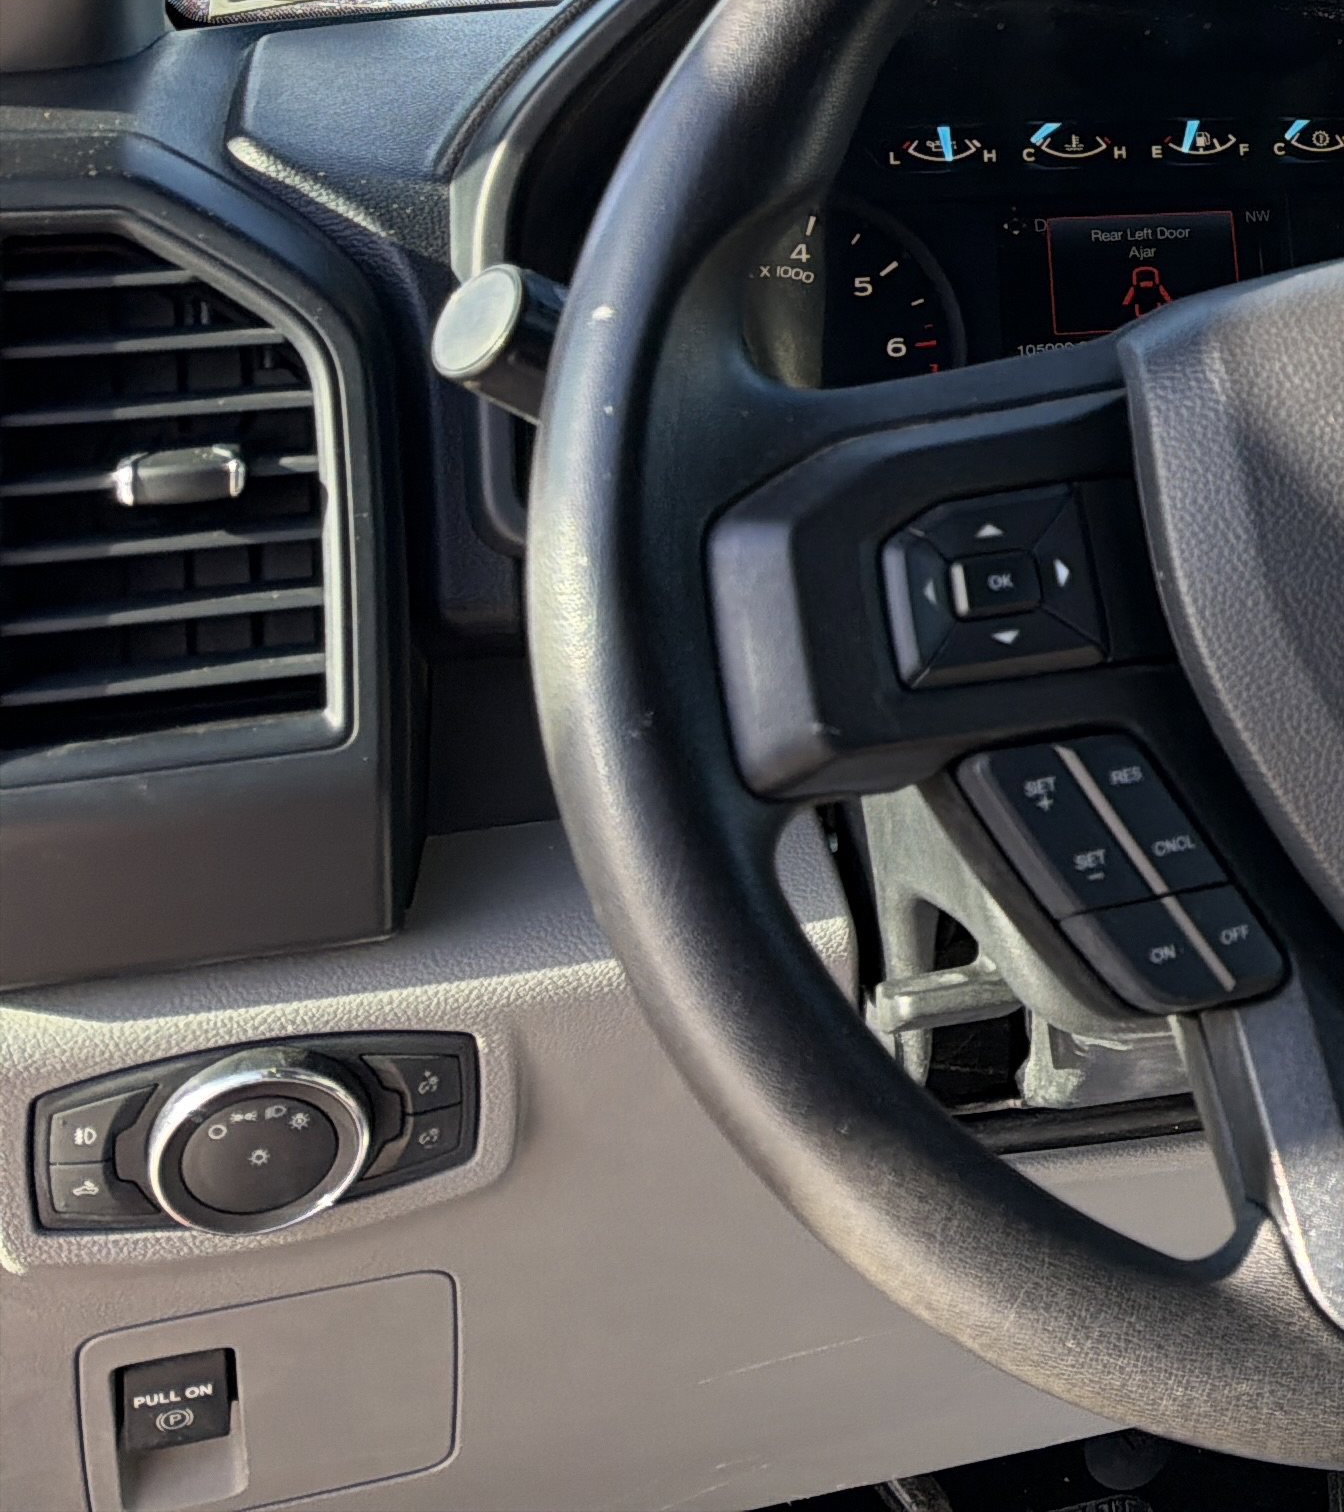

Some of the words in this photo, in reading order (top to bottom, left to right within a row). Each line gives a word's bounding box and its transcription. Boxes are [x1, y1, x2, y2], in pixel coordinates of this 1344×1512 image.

[889, 151, 901, 165] L
[983, 149, 997, 163] H
[1022, 148, 1035, 162] C
[1113, 145, 1127, 160] H
[1151, 145, 1163, 159] E
[1238, 143, 1249, 157] F
[1273, 142, 1286, 156] C
[1245, 210, 1270, 223] NW
[1091, 228, 1122, 243] Rear
[1127, 228, 1153, 240] Left
[1157, 226, 1190, 239] Door
[789, 243, 811, 263] 4
[1128, 246, 1157, 260] Ajar
[776, 265, 815, 284] 1000
[853, 276, 873, 297] 5
[886, 337, 907, 358] 6
[987, 573, 1014, 591] OK
[1109, 767, 1143, 785] RES
[1024, 776, 1056, 798] SET
[1153, 836, 1195, 857] CNCL
[1074, 849, 1105, 871] SET
[1220, 925, 1249, 945] OFF
[1151, 944, 1176, 964] ON
[133, 1390, 182, 1409] PULL
[184, 1383, 213, 1399] ON
